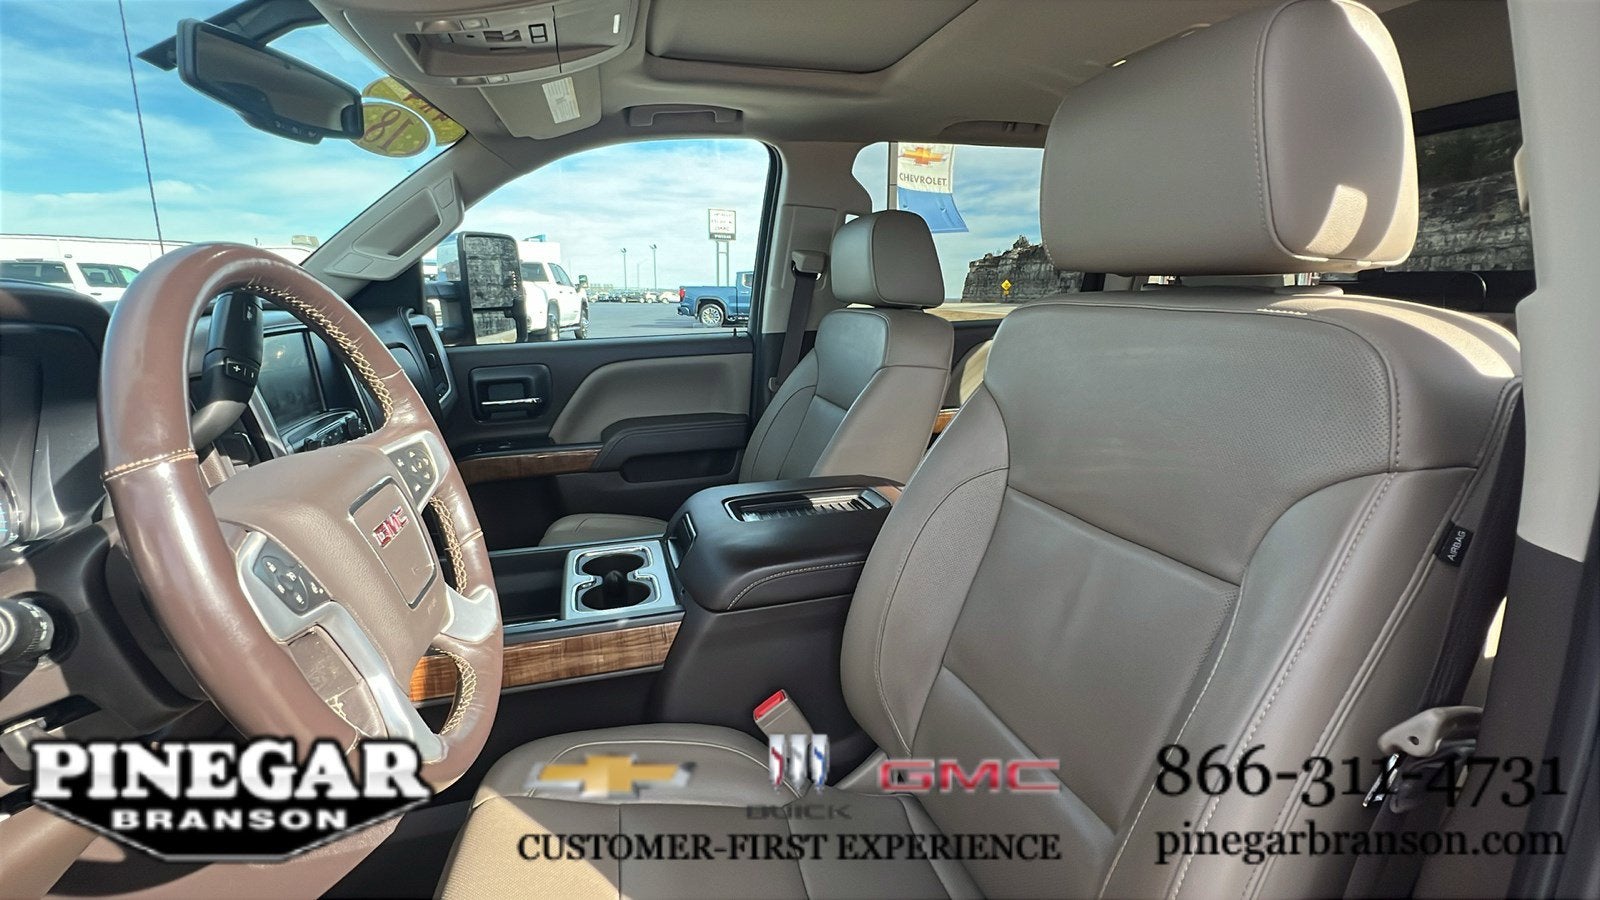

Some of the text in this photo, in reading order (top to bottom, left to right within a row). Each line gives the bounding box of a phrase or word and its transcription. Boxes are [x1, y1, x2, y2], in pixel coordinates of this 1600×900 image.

[899, 172, 948, 186] CHEVROLET
[372, 505, 409, 549] GMC
[1447, 530, 1466, 561] AIRBAG
